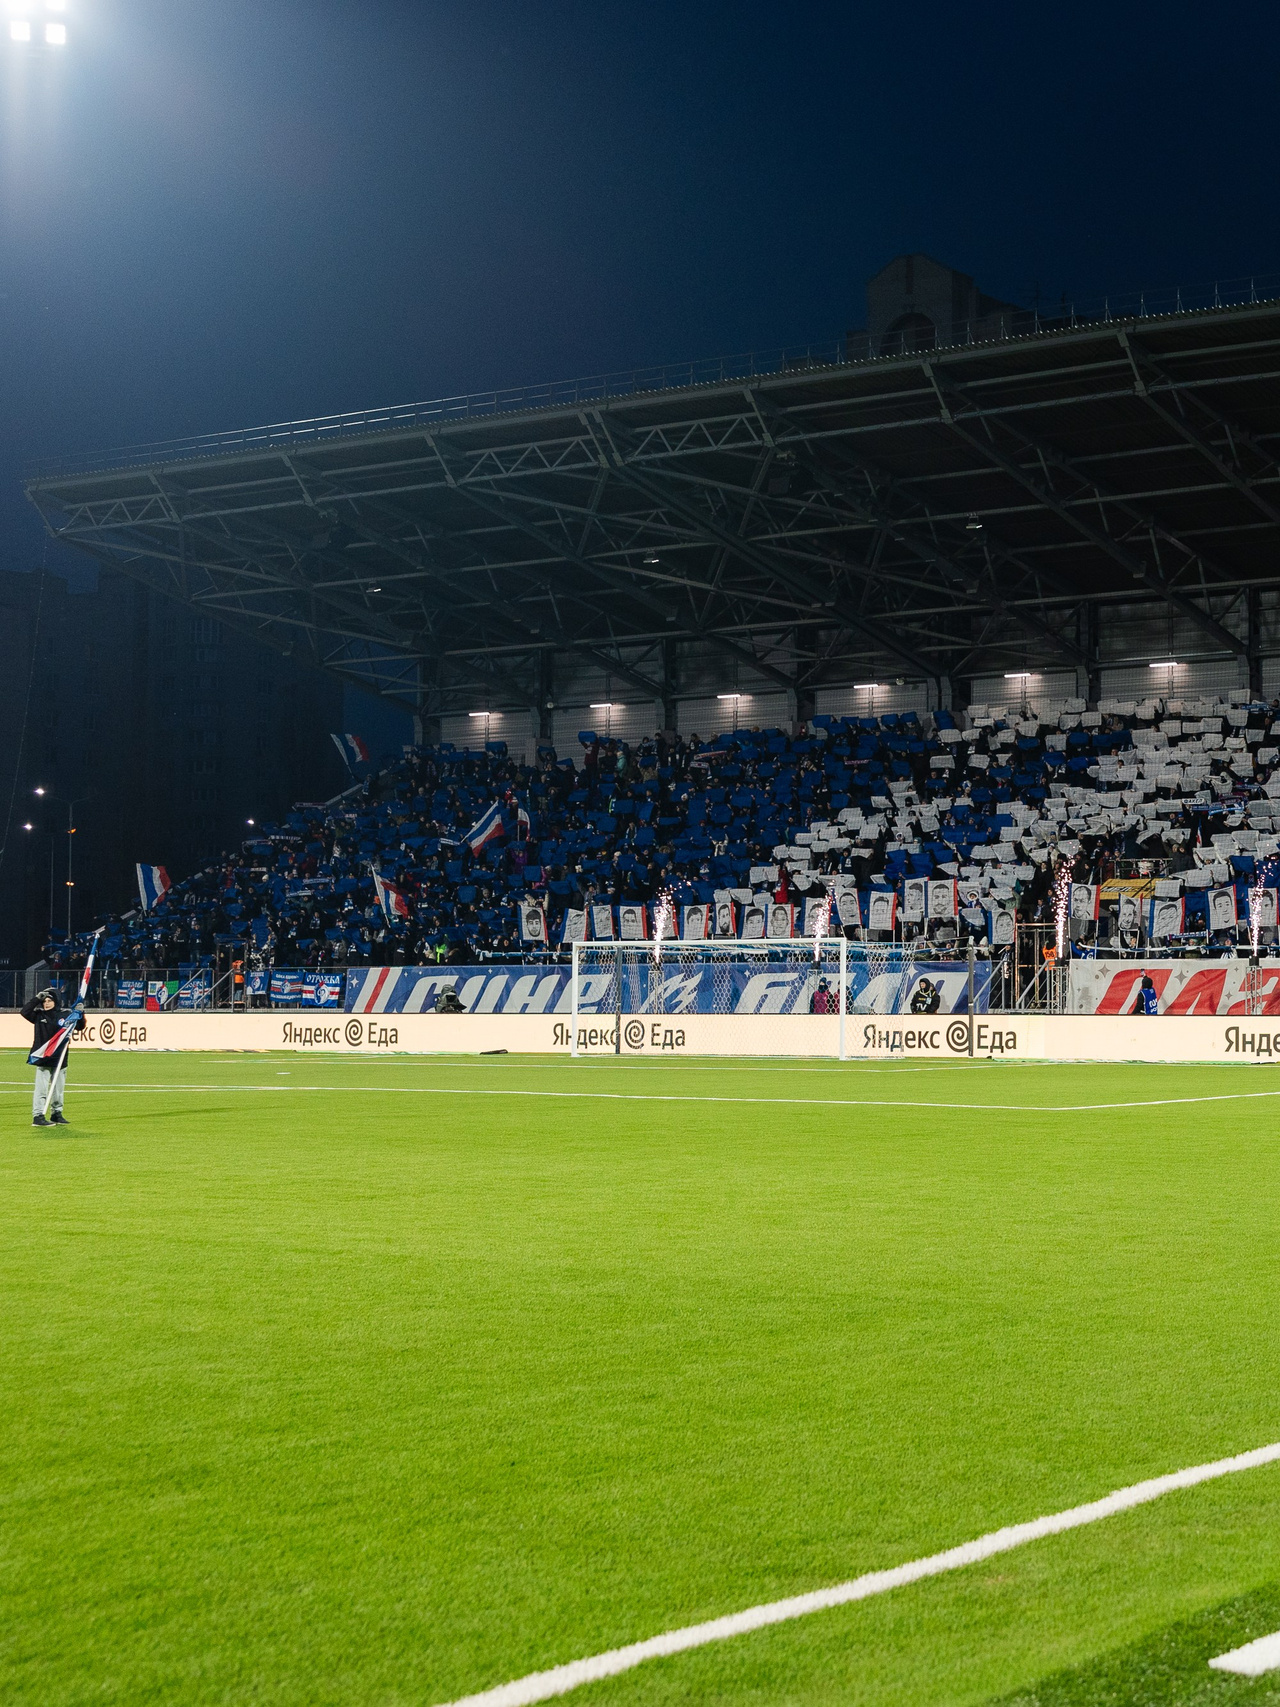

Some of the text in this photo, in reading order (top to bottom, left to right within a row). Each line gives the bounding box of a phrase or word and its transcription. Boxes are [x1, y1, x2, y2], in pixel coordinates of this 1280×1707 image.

[916, 1003, 927, 1011] TV
[120, 1022, 146, 1044] Еда
[283, 1022, 397, 1047] Яндекс Еда
[651, 1023, 685, 1049] Еда
[863, 1024, 1017, 1053] Яндекс Еда
